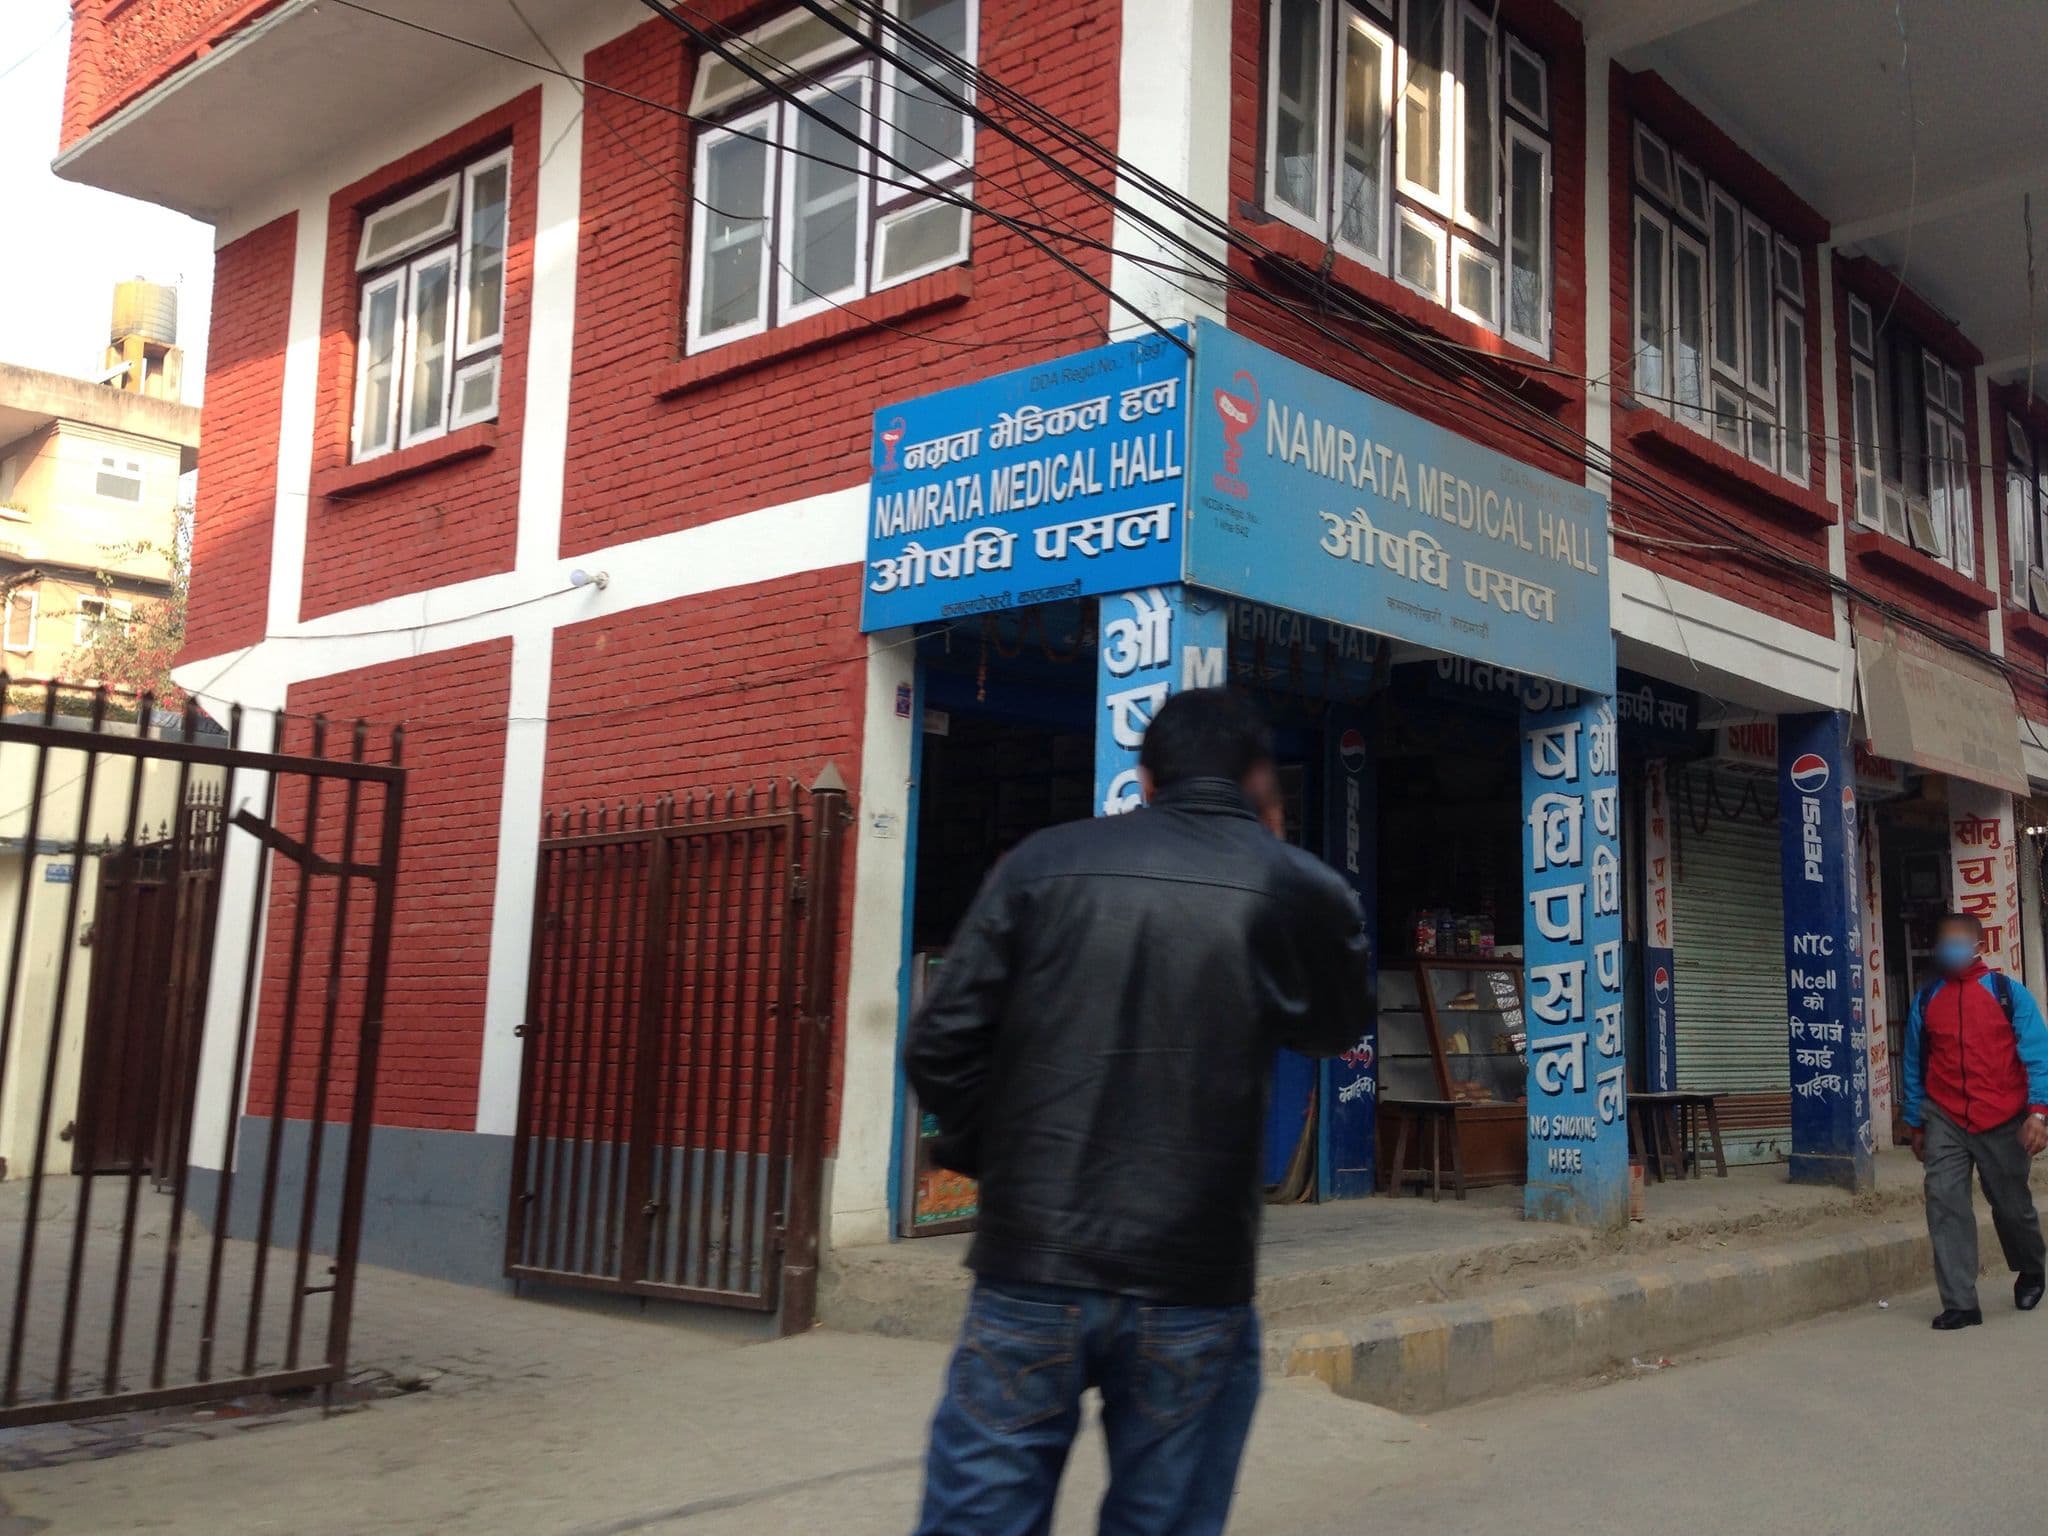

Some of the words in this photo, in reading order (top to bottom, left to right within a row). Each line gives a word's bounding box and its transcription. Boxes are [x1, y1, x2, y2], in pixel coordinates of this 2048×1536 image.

[989, 395, 1112, 451] मेडिकल
[1119, 377, 1180, 423] हल
[874, 473, 984, 541] NAMRATA
[989, 446, 1105, 516] MEDICAL
[1110, 429, 1182, 491] HALL
[1265, 398, 1411, 509] NAMRATA
[1417, 462, 1533, 553] MEDICAL
[1538, 510, 1600, 575] HALL
[869, 527, 1018, 595] औषधि
[1033, 502, 1176, 562] पसल
[1319, 506, 1450, 591] औषधि
[1463, 559, 1558, 623] पसल
[1346, 776, 1361, 875] PEPSI
[1801, 796, 1825, 883] PEPSI
[1791, 968, 1837, 990] Ncell
[1803, 992, 1825, 1012] को
[1658, 1006, 1668, 1092] PEPSI
[1796, 1045, 1835, 1070] कार्ड
[1530, 1115, 1550, 1140] NO
[1548, 1148, 1583, 1174] HERE
